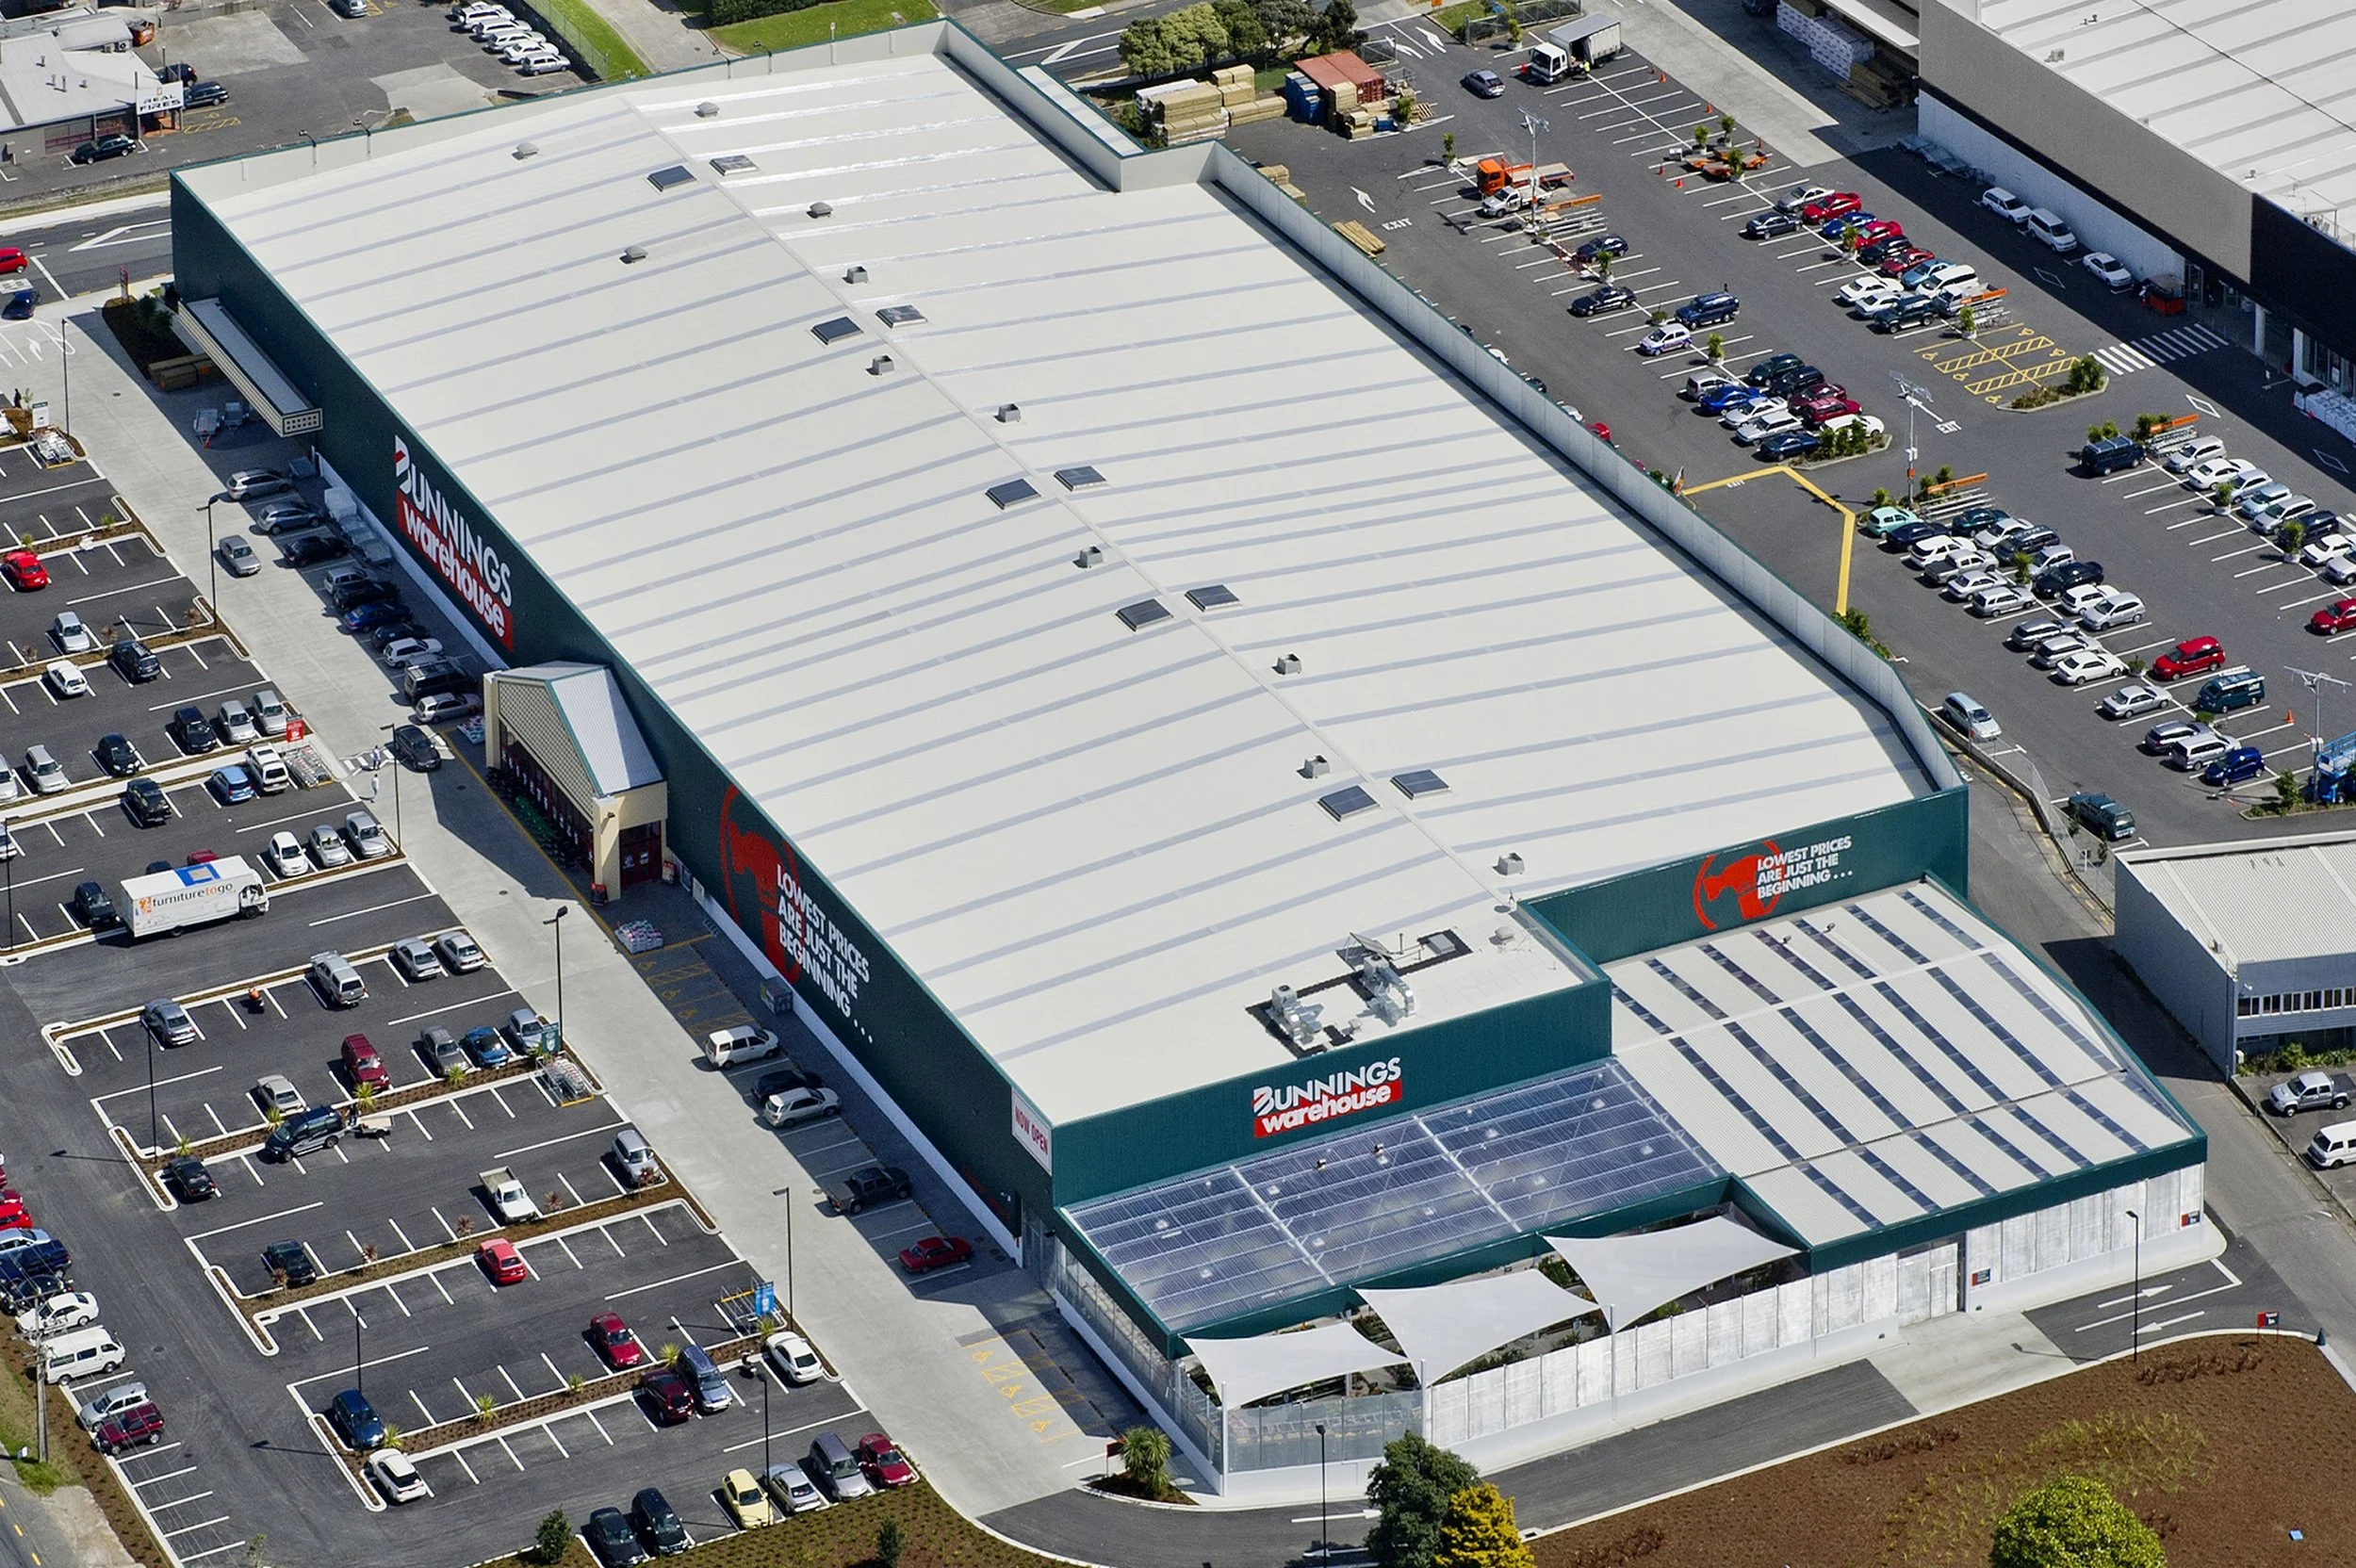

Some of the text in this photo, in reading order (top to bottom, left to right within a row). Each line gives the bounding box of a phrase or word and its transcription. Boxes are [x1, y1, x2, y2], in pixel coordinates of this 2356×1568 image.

[139, 99, 181, 111] FIRES
[1382, 218, 1413, 231] EXIT
[1935, 420, 1962, 434] EXIT
[394, 434, 513, 608] BUNNINGS
[402, 499, 505, 638] warehouse
[1757, 835, 1853, 872] LOWEST PRICES
[1757, 853, 1840, 886] ARE JUST THE
[777, 863, 871, 984] LOWEST PRICES
[777, 895, 859, 1000] ARE JUST THE
[1253, 1056, 1402, 1117] BUNNINGS
[1262, 1085, 1392, 1134] warehouse
[1015, 1105, 1049, 1156] NOW OPEN
